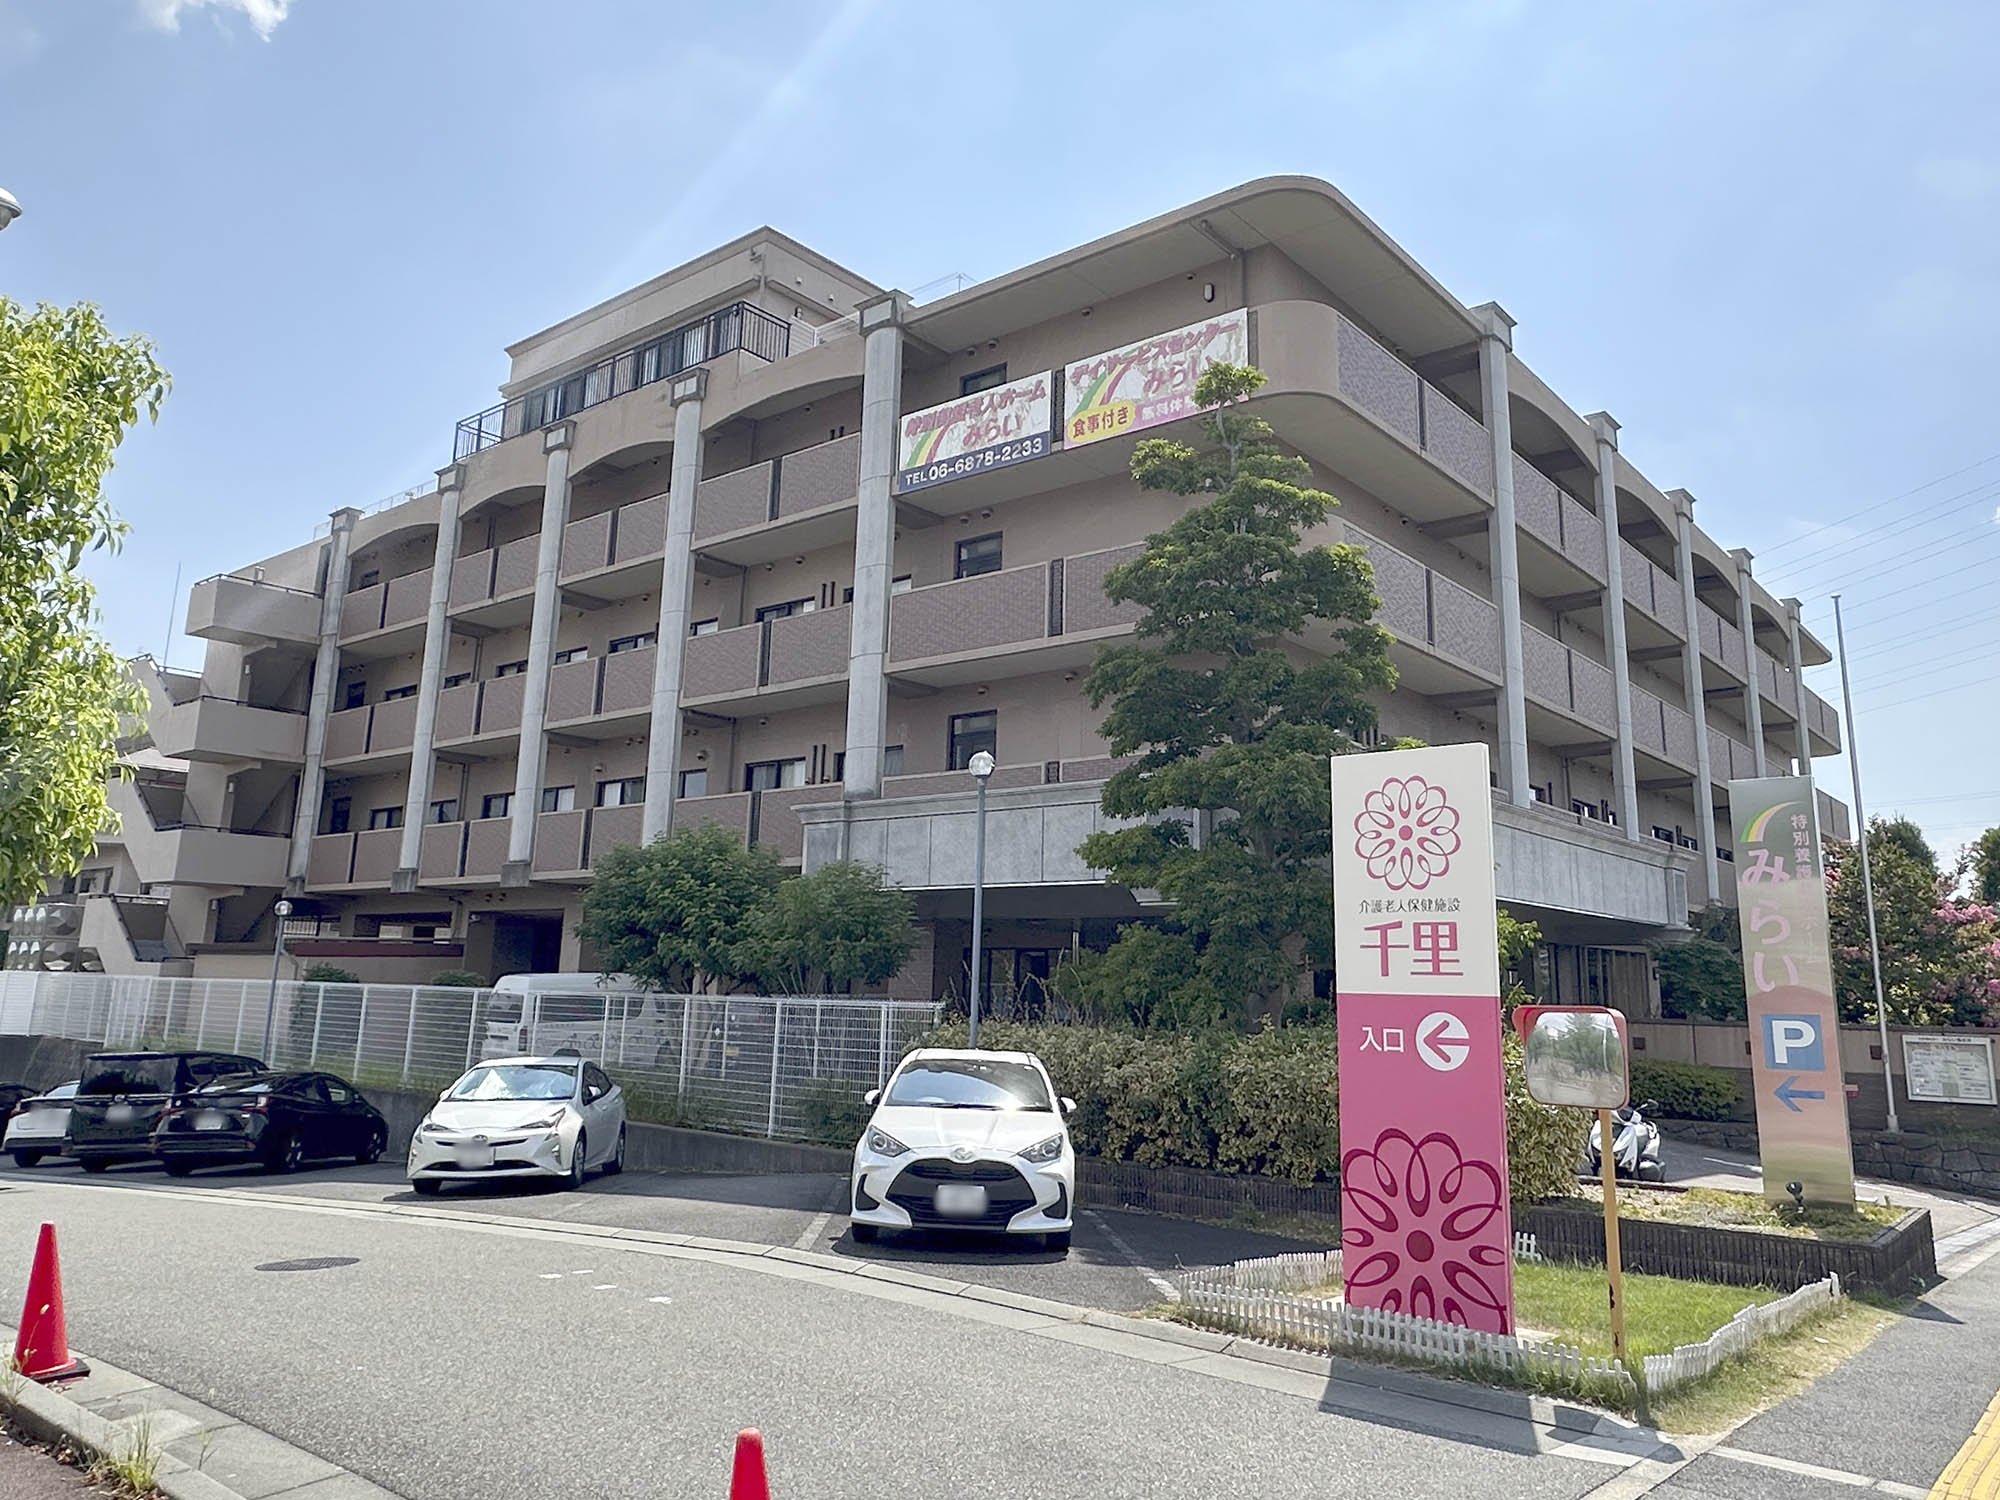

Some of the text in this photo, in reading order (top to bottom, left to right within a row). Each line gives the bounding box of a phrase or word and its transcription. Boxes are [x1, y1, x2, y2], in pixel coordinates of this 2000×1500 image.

[1073, 406, 1129, 438] 食事付き
[905, 438, 1043, 486] TEL 06-6878-2233
[1359, 897, 1461, 914] 介護老人保健施設
[1742, 848, 1800, 993] みらい
[1360, 920, 1464, 977] 千里
[1359, 1026, 1405, 1053] 入口
[1771, 1020, 1816, 1064] P
